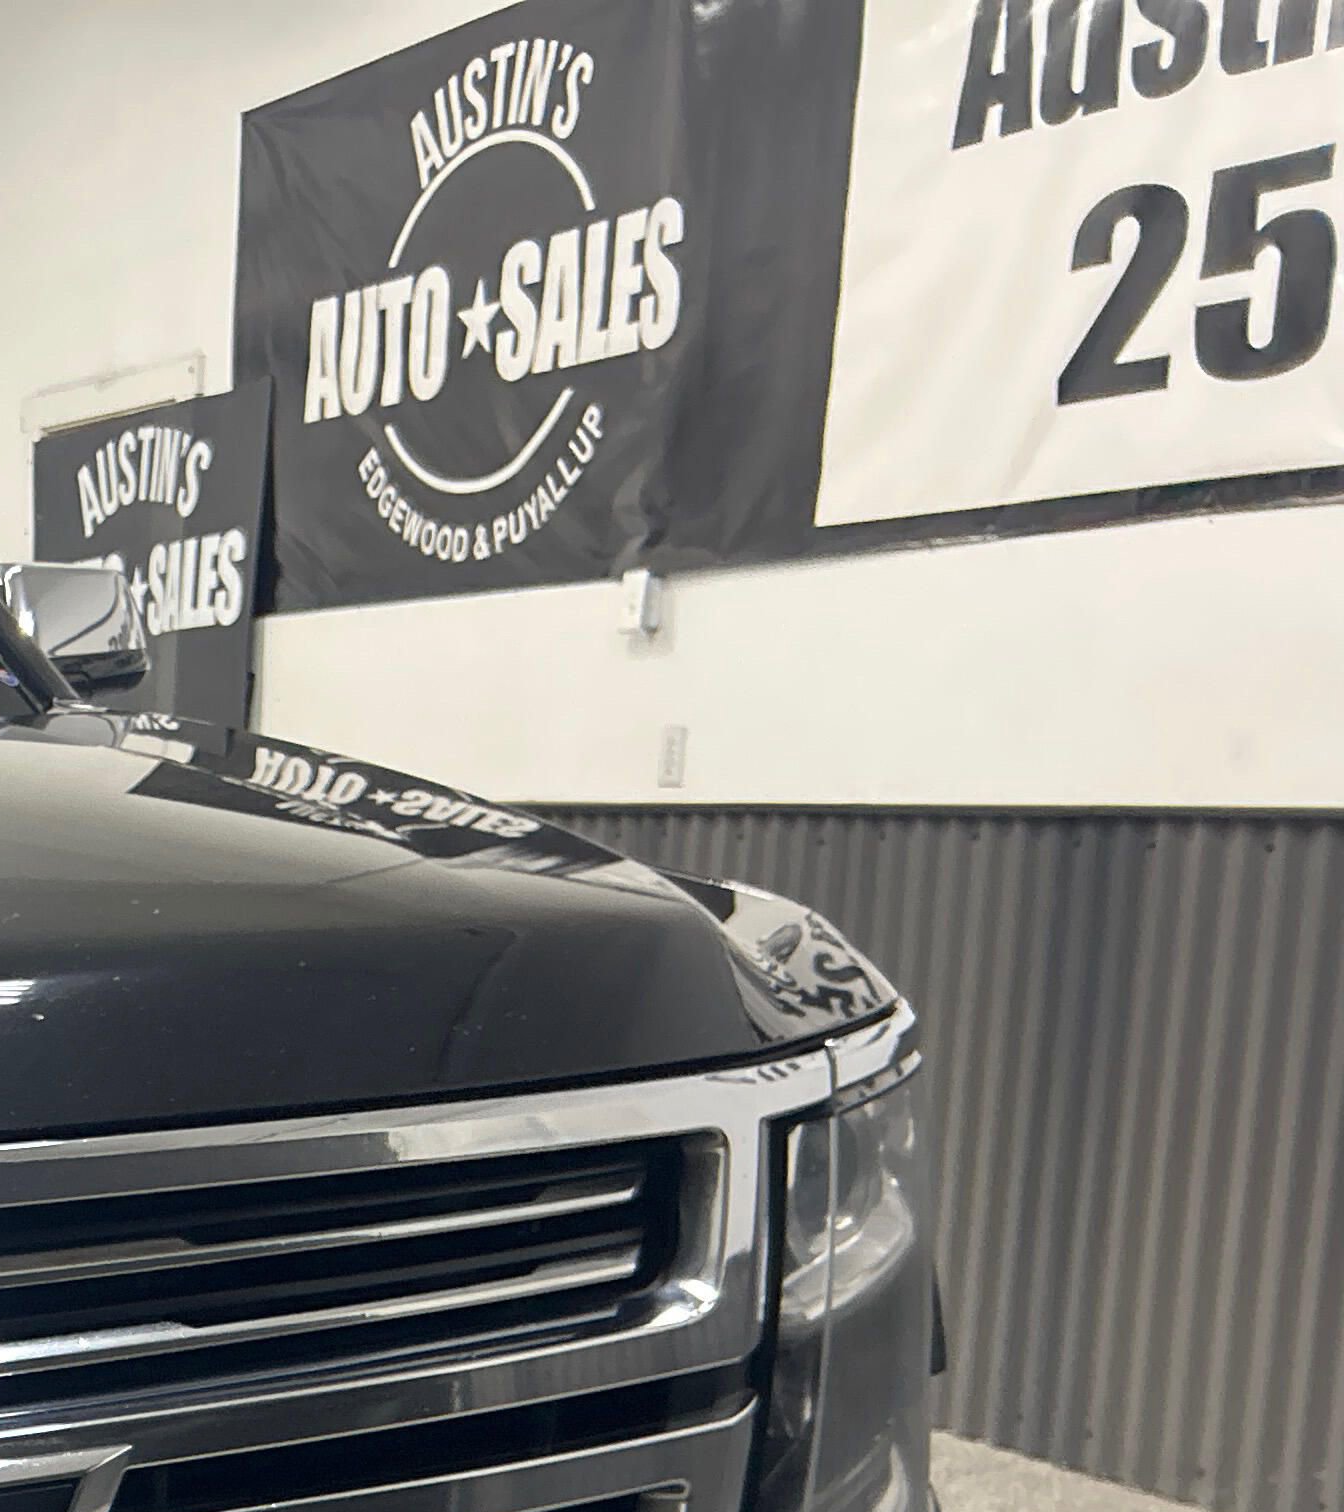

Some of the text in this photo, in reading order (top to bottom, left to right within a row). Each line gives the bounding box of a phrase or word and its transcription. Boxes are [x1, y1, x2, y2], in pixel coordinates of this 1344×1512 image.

[409, 37, 594, 189] AUSTIN'S
[303, 196, 685, 424] AUTO SALES
[1057, 142, 1337, 407] 25
[77, 425, 212, 538] AUSTIN'S
[357, 402, 605, 564] EDGEWOOD & PUYALLUP
[147, 528, 246, 636] SALES
